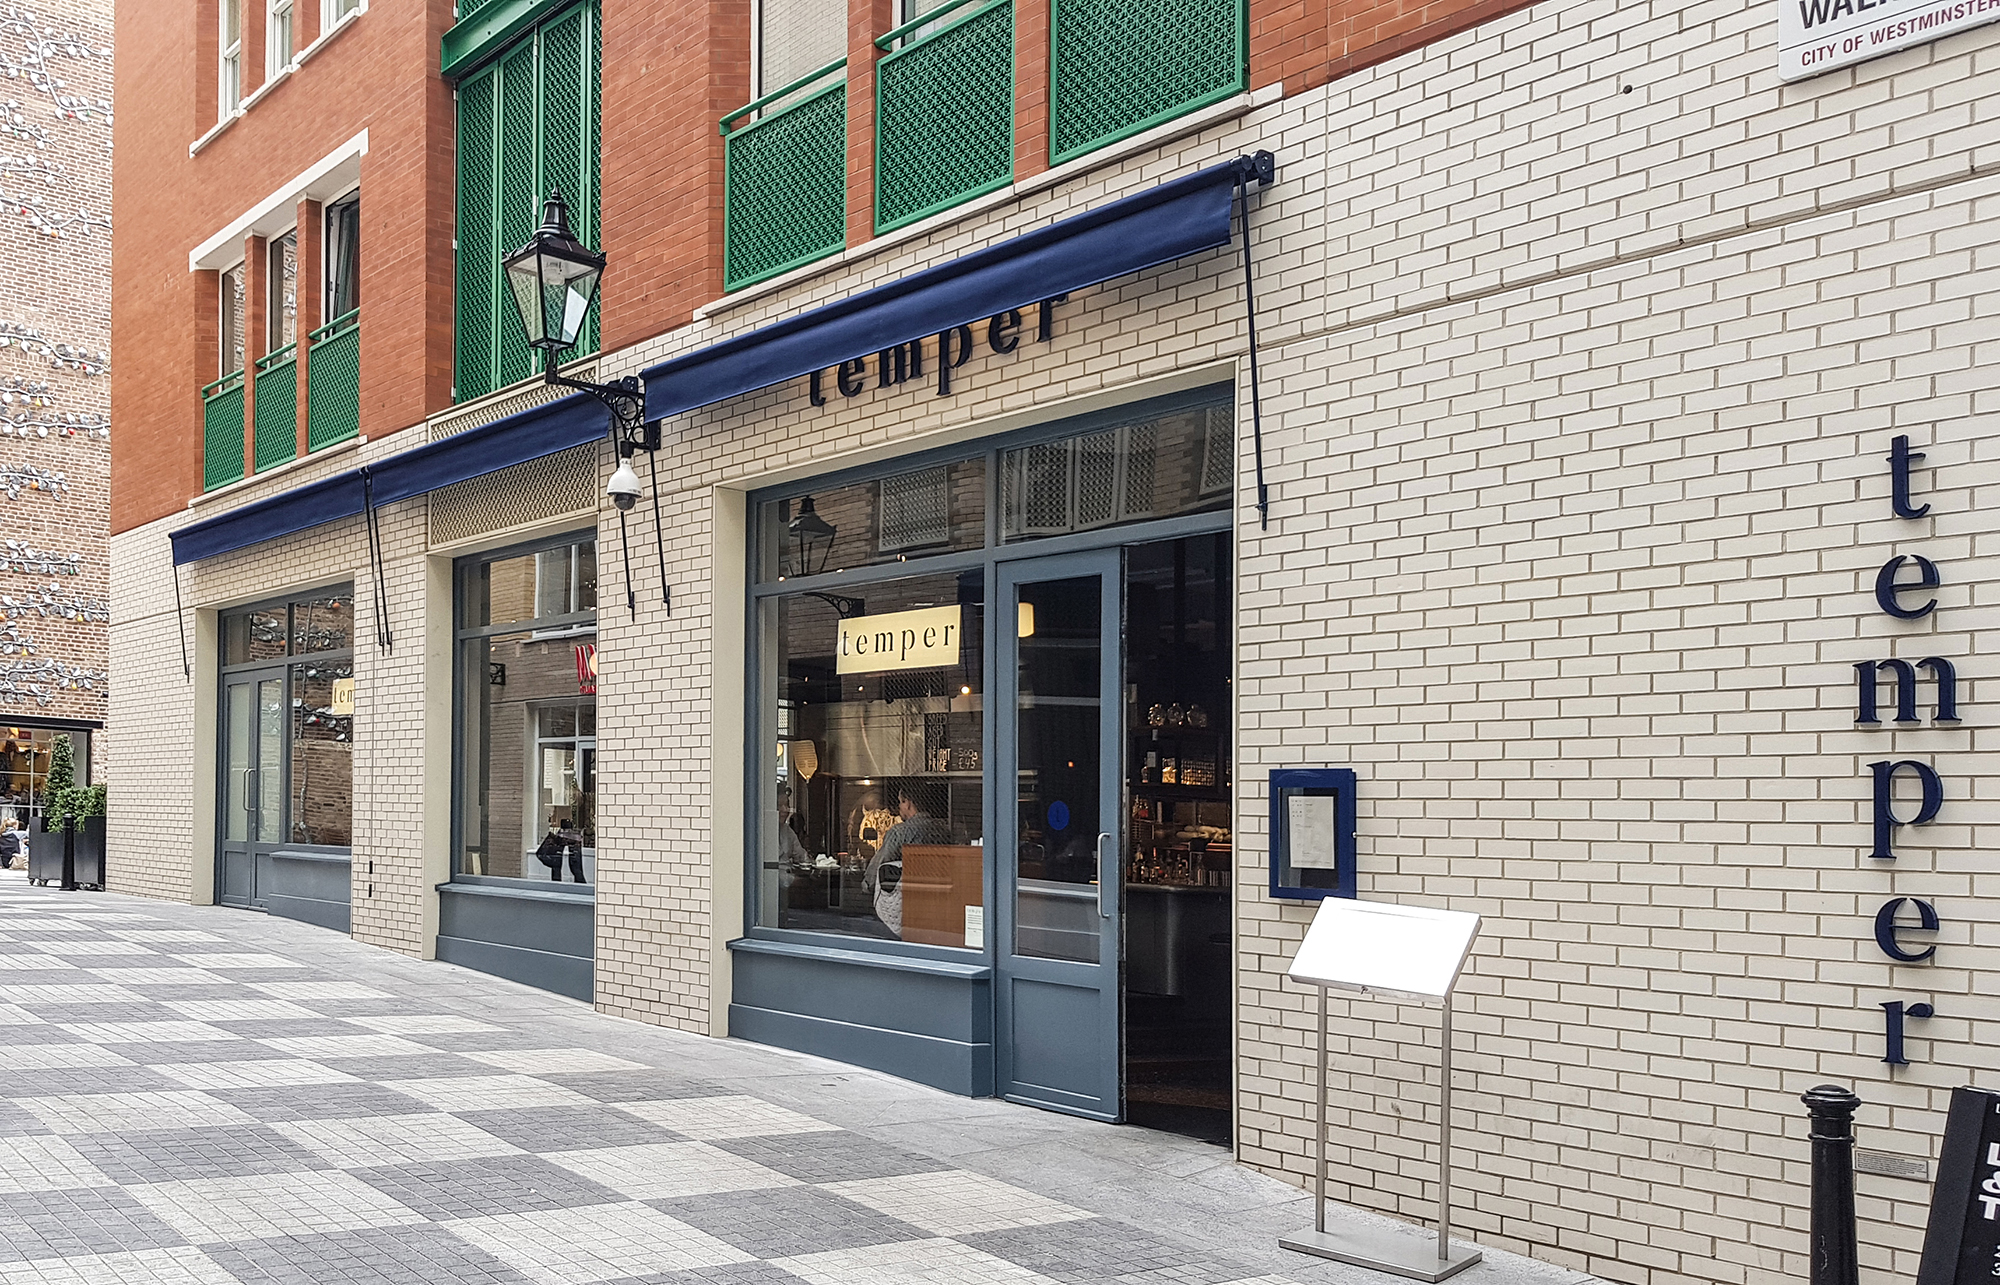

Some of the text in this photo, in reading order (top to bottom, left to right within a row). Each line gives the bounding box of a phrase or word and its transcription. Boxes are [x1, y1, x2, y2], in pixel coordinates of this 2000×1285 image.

[1798, 0, 1898, 29] WAL
[1801, 0, 2000, 67] CITY OF WESTMINSTER
[809, 292, 1069, 408] temper
[842, 624, 955, 662] temper
[1852, 434, 1963, 1065] temper
